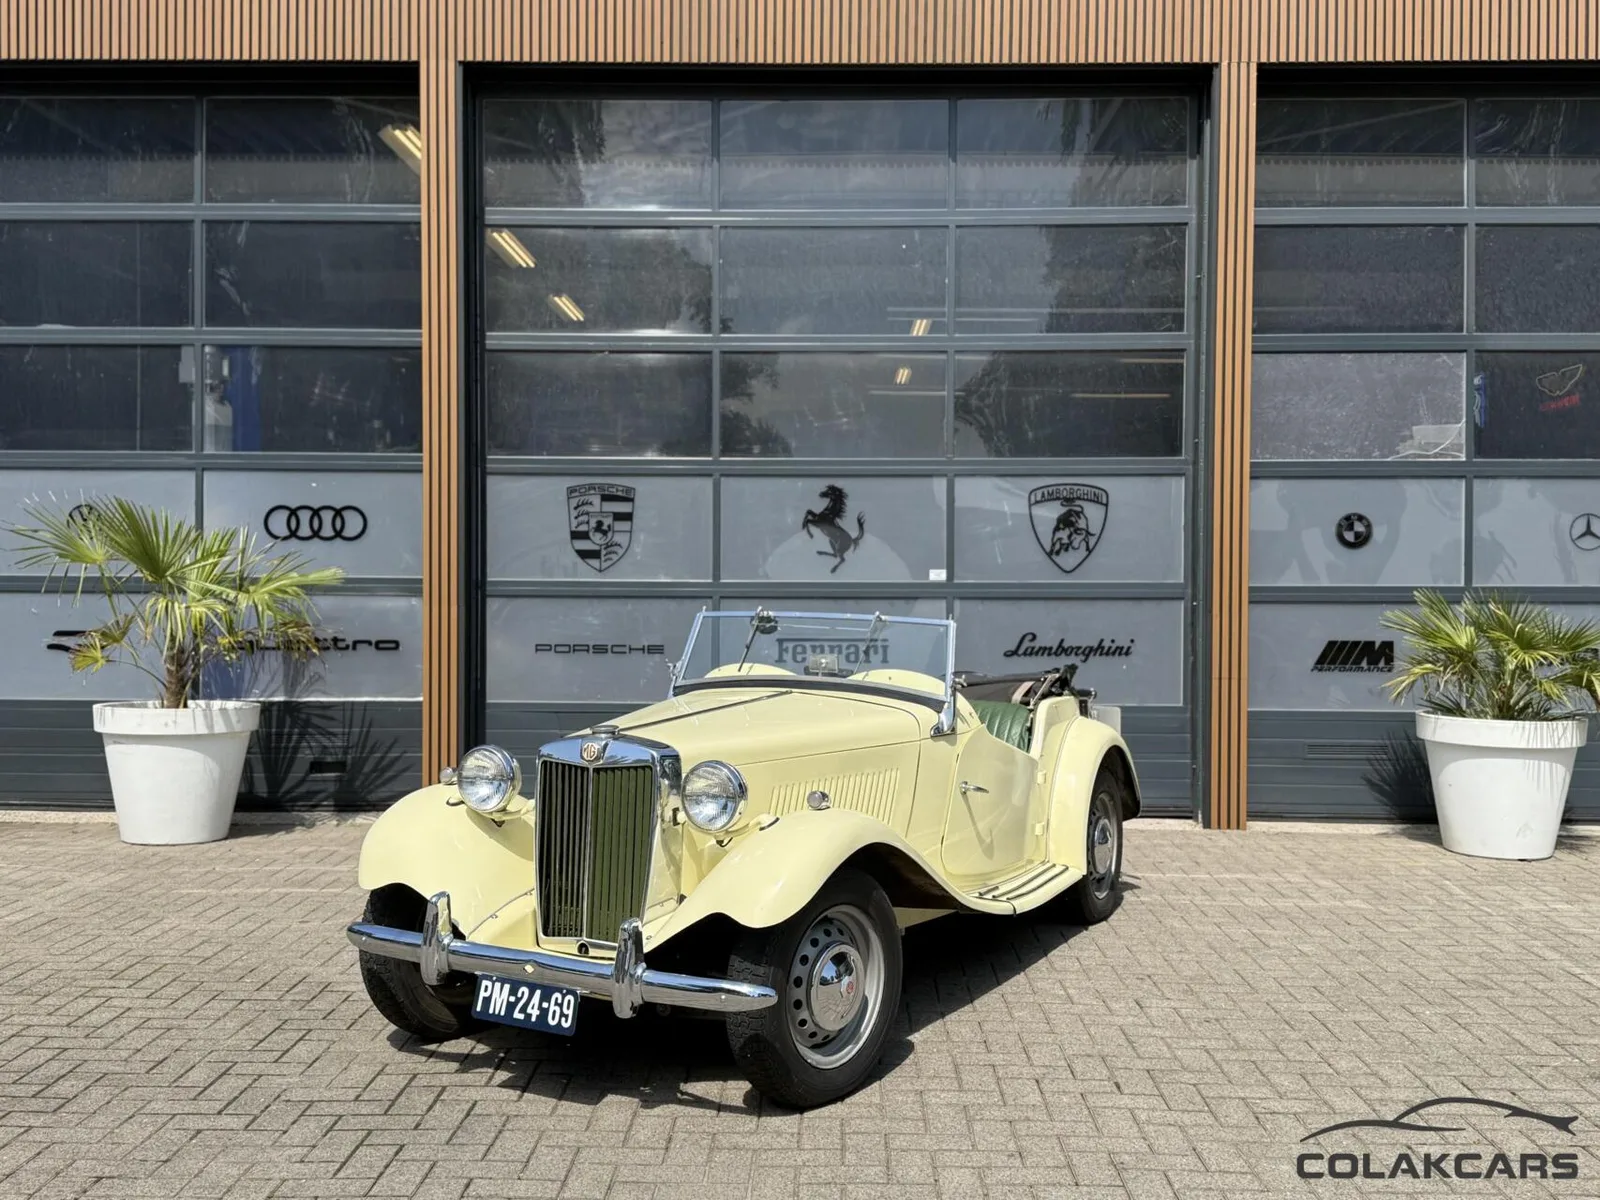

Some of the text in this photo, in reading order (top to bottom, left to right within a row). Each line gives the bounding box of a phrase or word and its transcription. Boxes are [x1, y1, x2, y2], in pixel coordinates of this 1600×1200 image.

[569, 485, 633, 496] PORSCHE
[1034, 487, 1103, 503] LAMBORGHINI
[535, 644, 665, 654] PORSCHE
[1003, 632, 1135, 663] Lamborghini
[583, 744, 597, 759] MG
[476, 979, 575, 1028] PM-24-69
